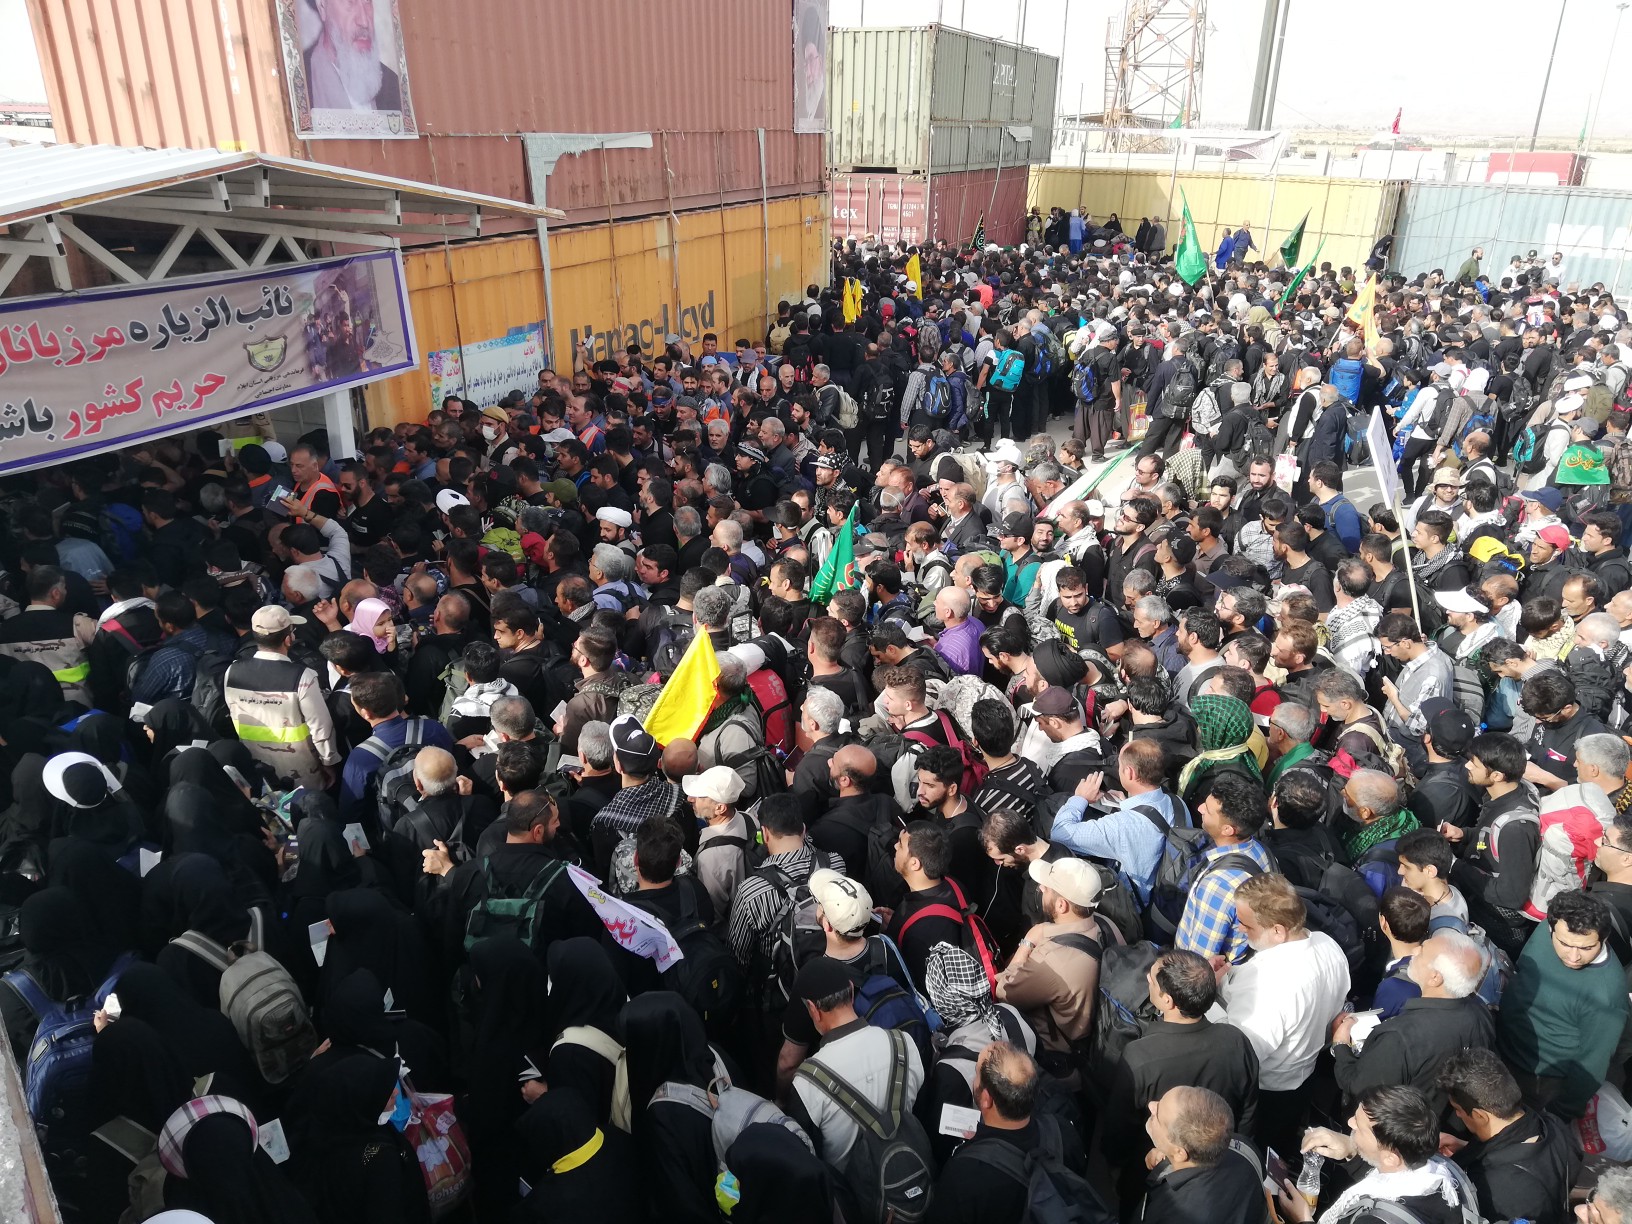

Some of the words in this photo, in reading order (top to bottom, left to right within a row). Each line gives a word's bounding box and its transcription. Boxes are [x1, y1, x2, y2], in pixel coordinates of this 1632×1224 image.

[62, 376, 144, 440] کشور
[151, 373, 227, 417] حریم
[0, 398, 55, 442] باش
